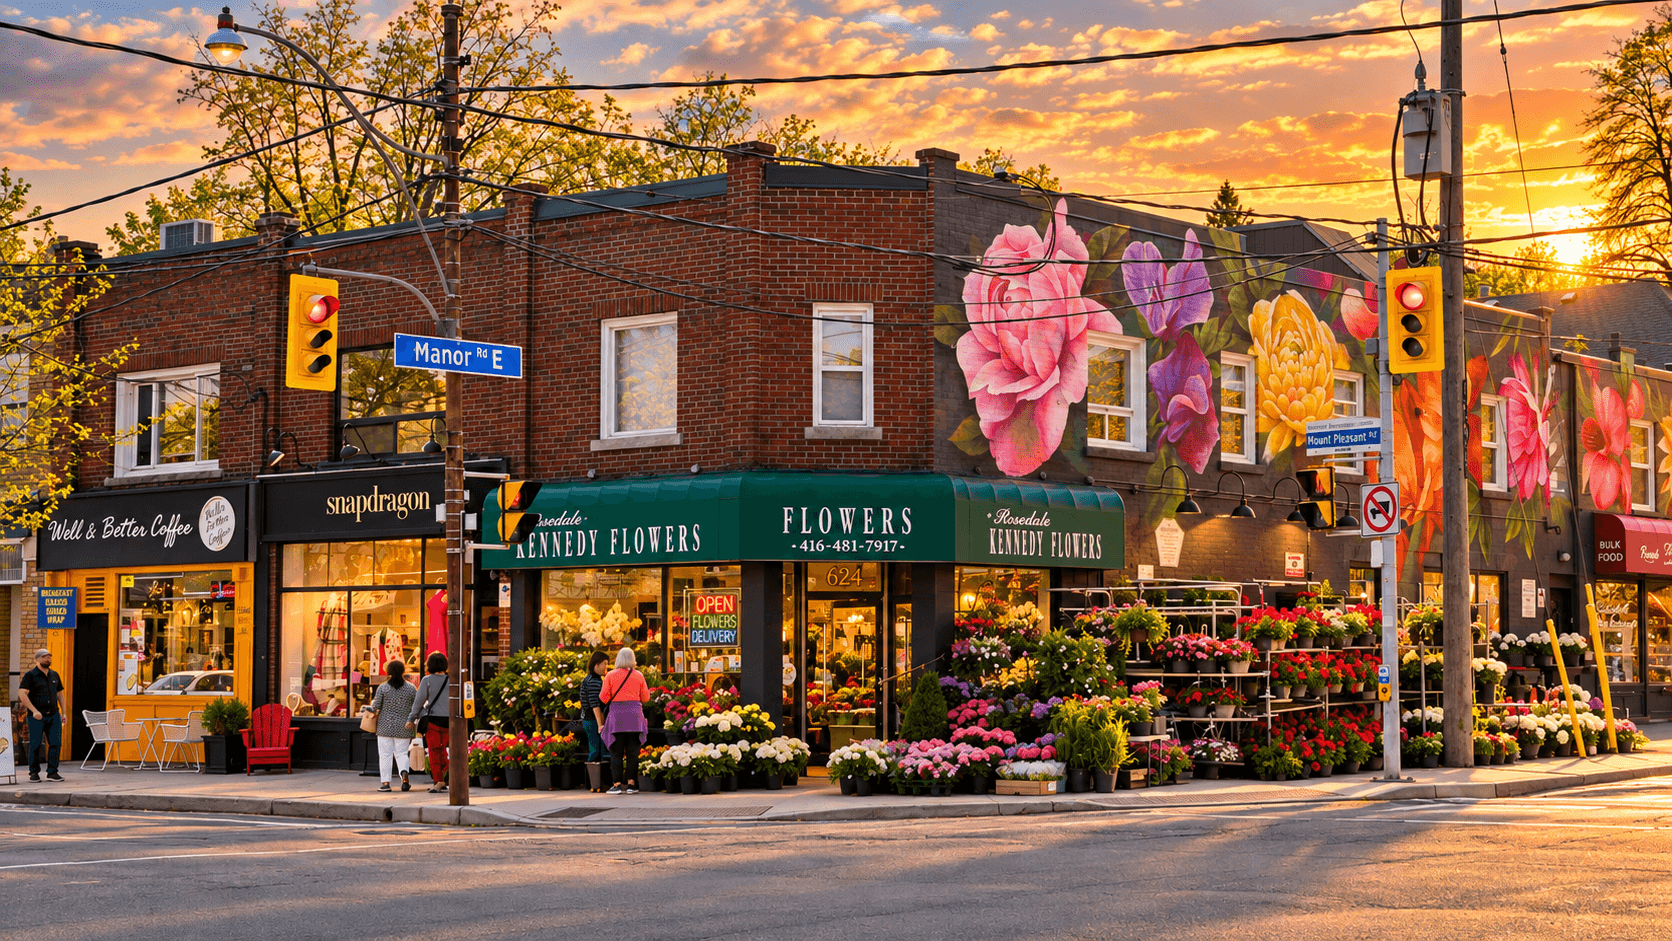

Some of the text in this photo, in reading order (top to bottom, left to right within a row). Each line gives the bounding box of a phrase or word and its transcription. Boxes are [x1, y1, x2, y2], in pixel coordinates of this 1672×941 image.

[414, 341, 503, 370] Manor Rd E
[1307, 435, 1331, 445] Mount
[1333, 433, 1367, 444] Pleasant
[325, 485, 431, 523] snapdragon
[782, 506, 913, 535] FLOWERS
[993, 508, 1051, 527] Rosedale
[48, 519, 84, 541] Well
[85, 522, 97, 540] &
[102, 516, 148, 539] Better
[150, 514, 194, 548] Coffee
[610, 524, 701, 556] FLOWERS
[799, 539, 898, 552] 416-481-7917
[989, 527, 1102, 560] KENNEDY FLOWERS
[1599, 540, 1621, 550] BULK
[1597, 553, 1624, 562] FOOD
[827, 565, 862, 587] 624
[696, 595, 734, 613] OPEN
[692, 614, 737, 629] FLOWERS
[691, 629, 737, 643] DELIVERY
